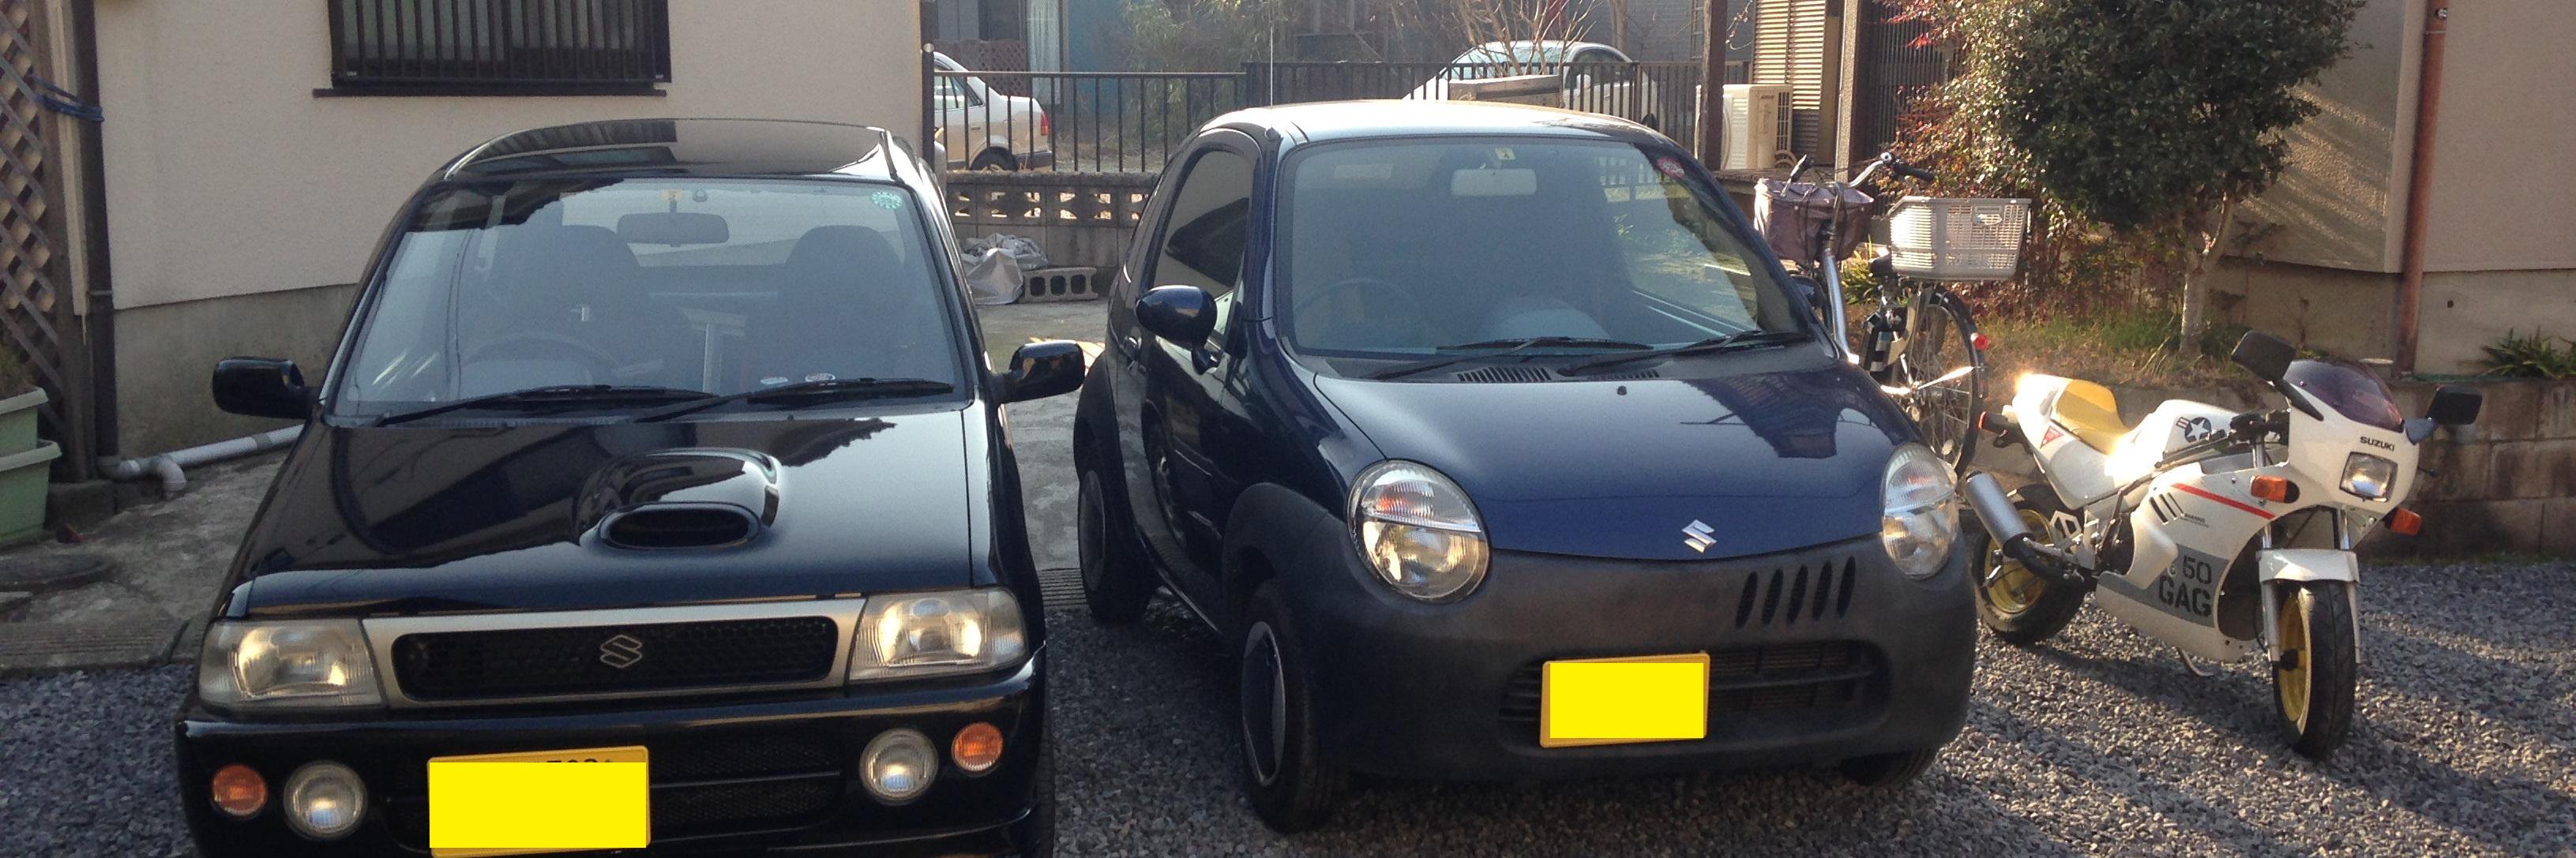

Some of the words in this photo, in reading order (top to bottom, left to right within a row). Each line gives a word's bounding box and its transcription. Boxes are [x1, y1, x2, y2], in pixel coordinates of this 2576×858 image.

[2360, 436, 2395, 451] SUZUKI
[2183, 555, 2212, 584] 50
[2159, 575, 2212, 617] GAG
